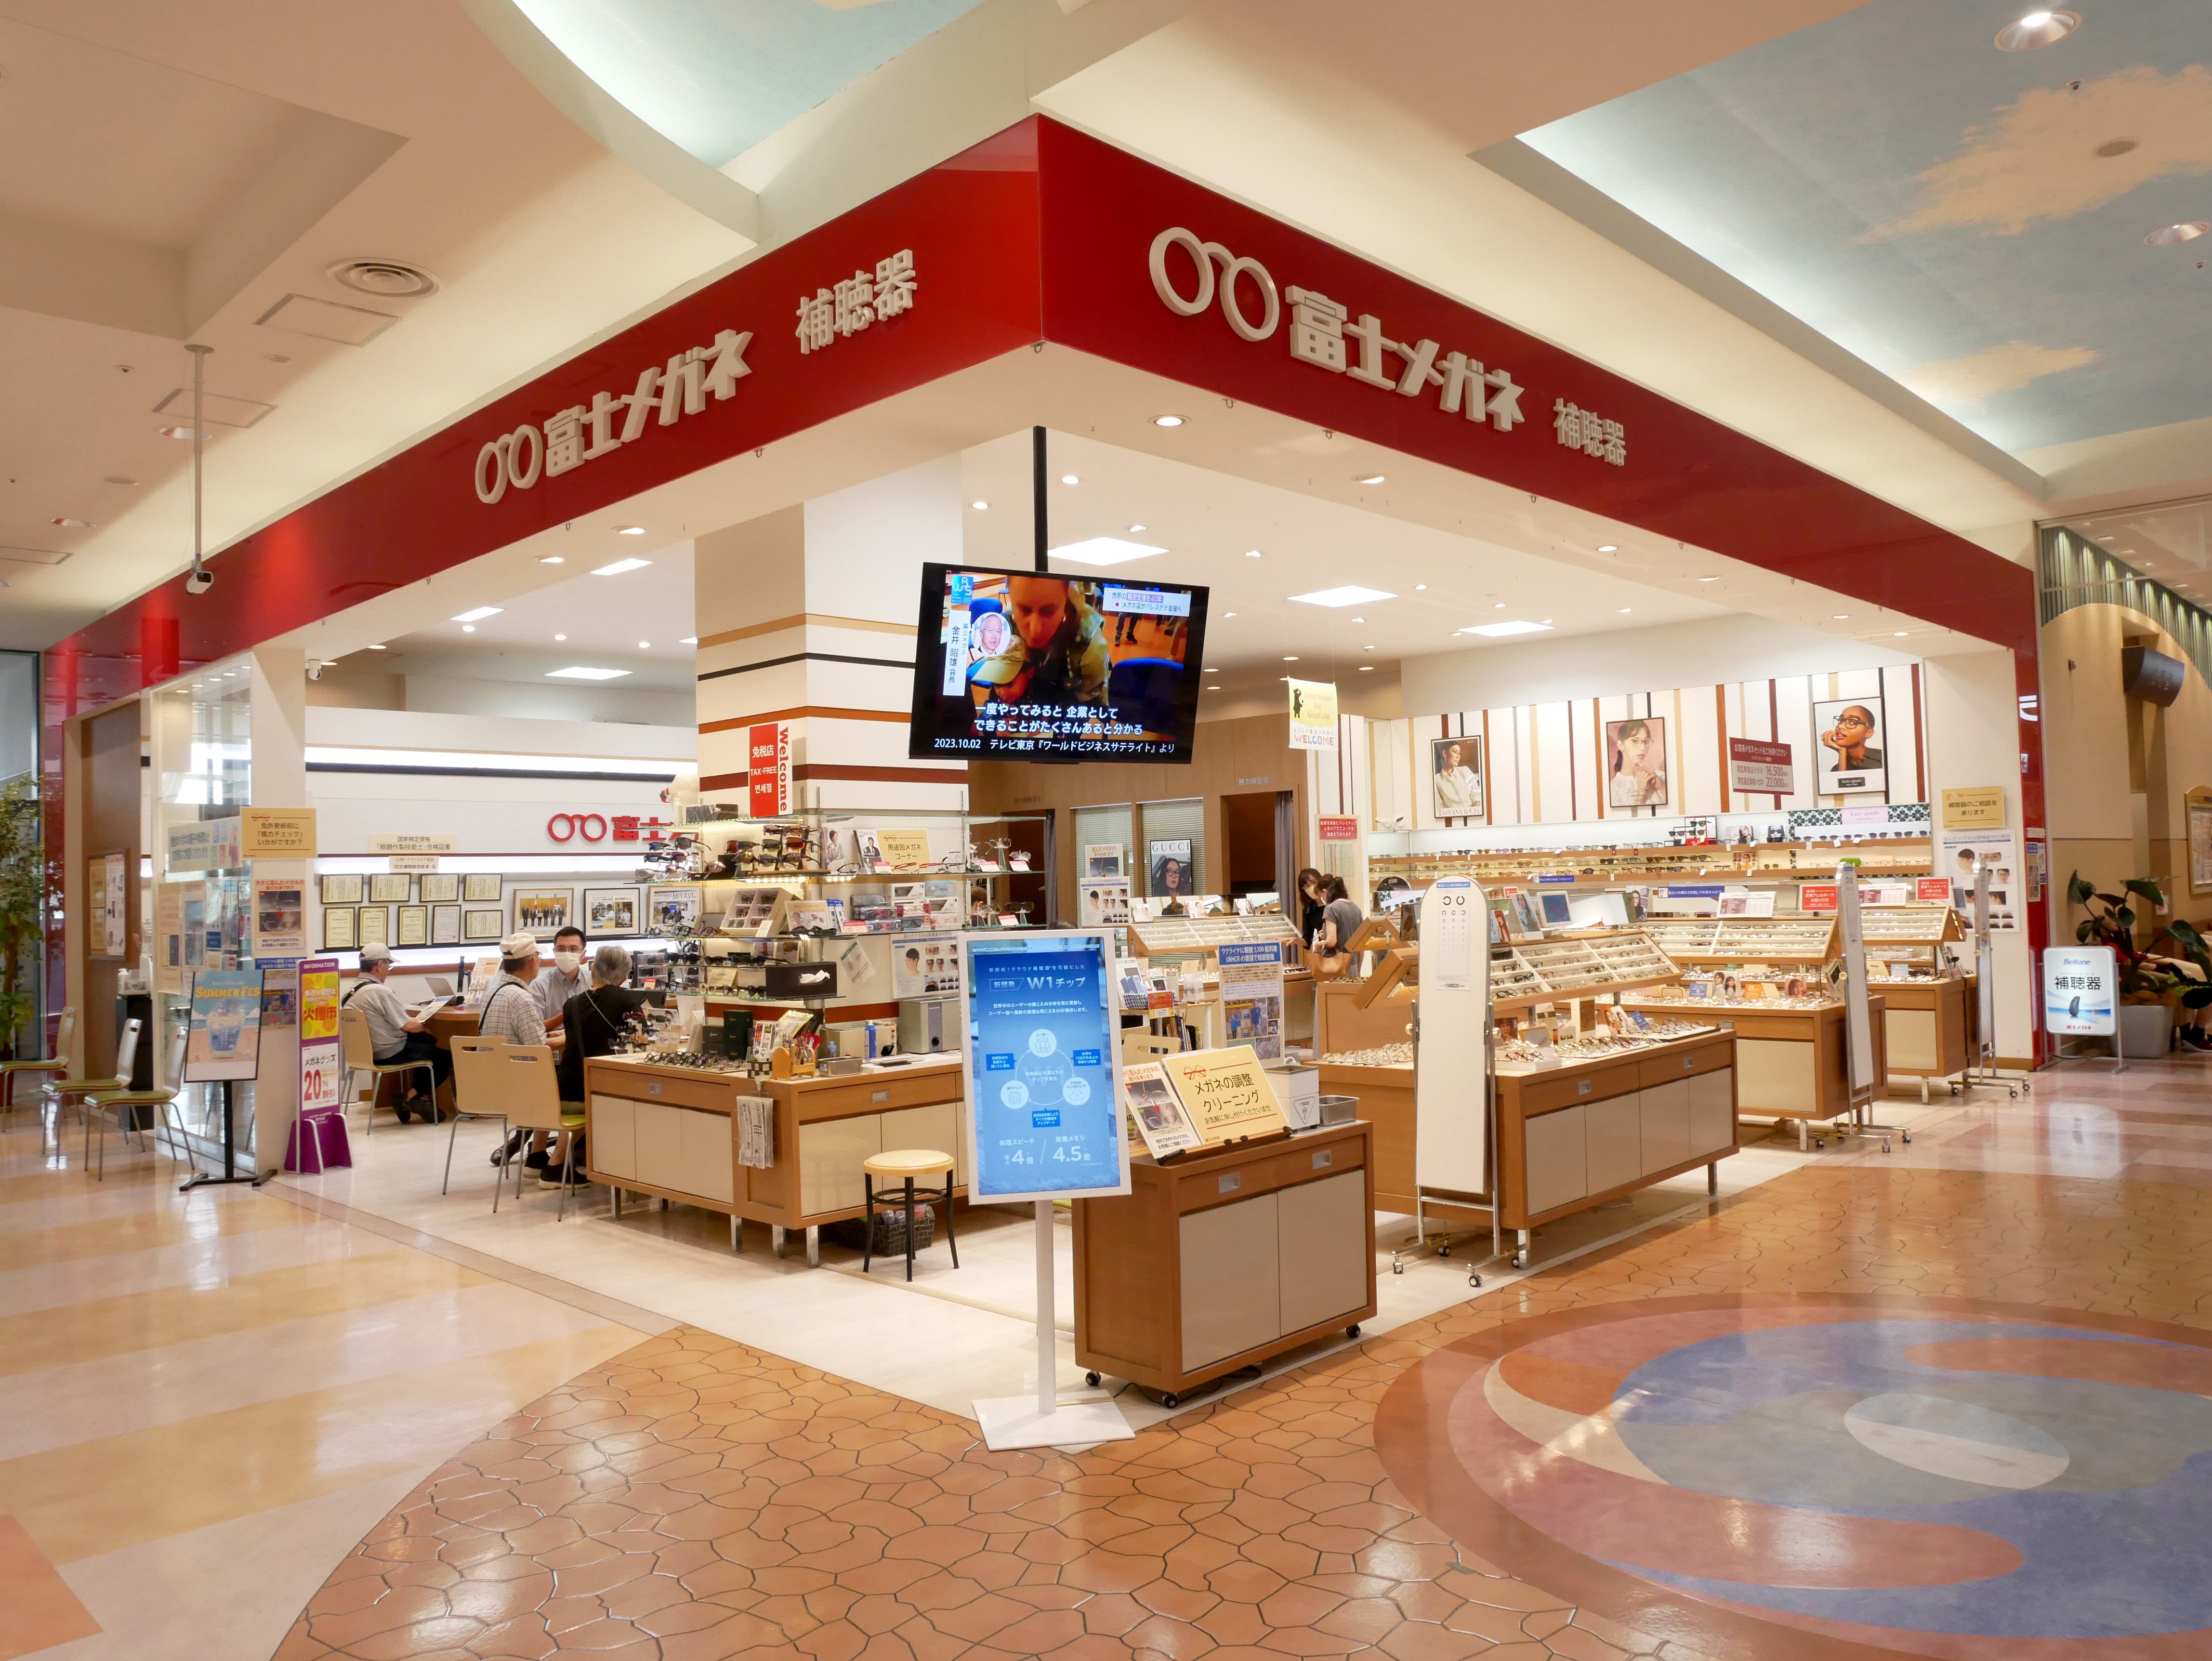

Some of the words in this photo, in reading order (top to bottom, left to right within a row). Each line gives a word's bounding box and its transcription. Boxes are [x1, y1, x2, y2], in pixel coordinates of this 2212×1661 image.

[796, 249, 917, 355] 補聴器
[1285, 284, 1525, 433] 富士メガネ
[544, 329, 753, 477] 富士メガネ
[1553, 397, 1626, 466] 補聴器
[951, 626, 960, 644] 金井
[949, 648, 959, 666] 昭雄
[948, 669, 956, 683] 会長
[975, 703, 1062, 718] 一度やってみると
[1066, 706, 1118, 720] 企業として
[974, 720, 1143, 736] できることがたくさんあると分かる
[934, 738, 981, 749] 2023.10.02
[1294, 734, 1333, 746] WELCOME
[752, 744, 774, 758] 免税店
[750, 766, 777, 776] TAX-FREE
[779, 727, 789, 811] Welcome
[1766, 766, 1783, 777] 16,500
[755, 783, 772, 794] 면세점
[1766, 778, 1784, 788] 22,000
[1152, 842, 1189, 852] GUCCI
[1027, 976, 1086, 989] W1チップ
[2054, 976, 2101, 990] 補聴器
[195, 987, 240, 999] SUMMER
[241, 987, 260, 997] FES
[304, 1054, 336, 1066] メガネグッズ
[303, 1069, 322, 1101] 20
[322, 1089, 335, 1099] 割引
[1195, 1072, 1255, 1095] メガネの調整
[1203, 1089, 1259, 1113] クリーニング
[1204, 1105, 1272, 1124] お気軽に申し付けくださいませ
[999, 1138, 1034, 1146] 処理スピード
